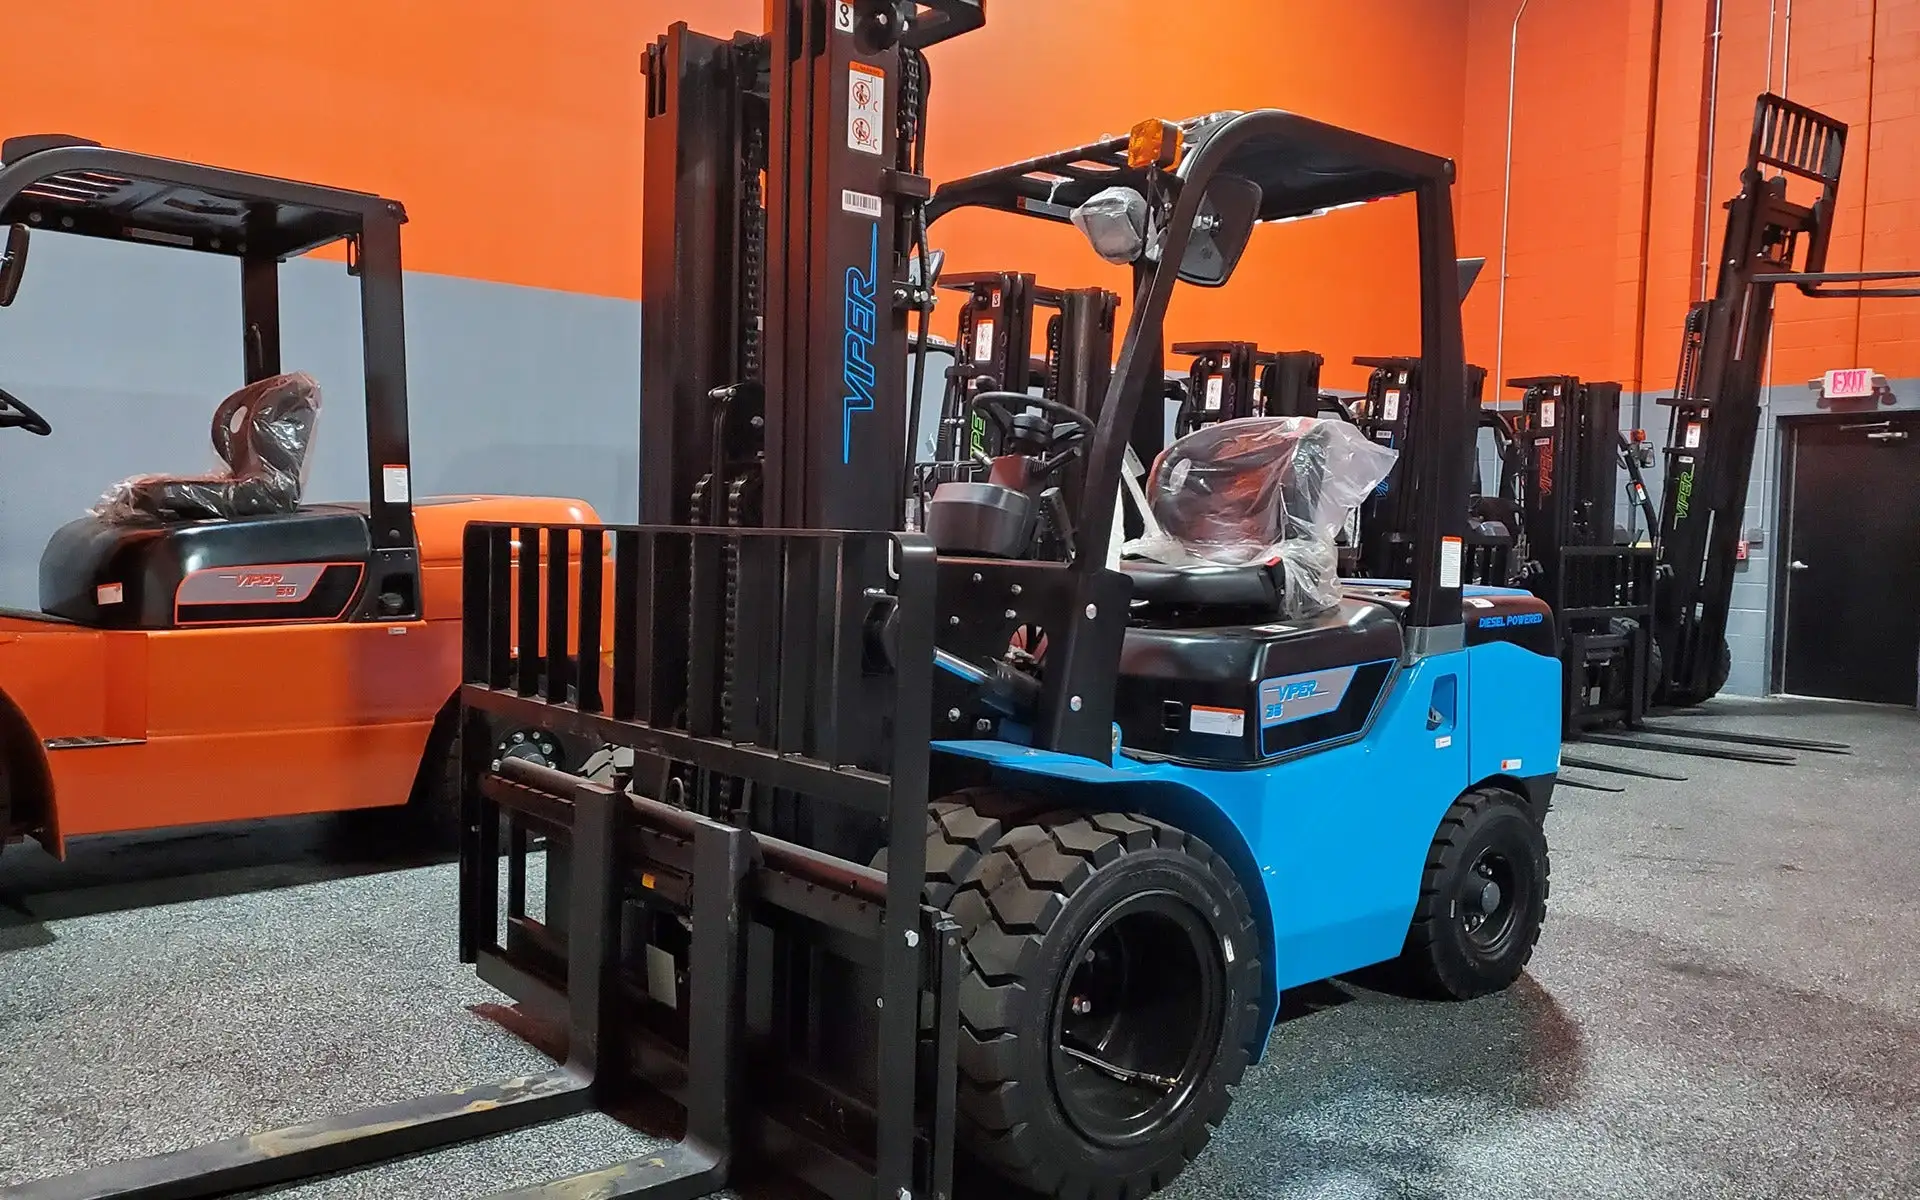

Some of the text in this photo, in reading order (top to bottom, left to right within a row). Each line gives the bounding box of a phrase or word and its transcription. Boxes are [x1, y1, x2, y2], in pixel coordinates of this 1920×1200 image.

[843, 223, 877, 464] VIPER
[1832, 371, 1867, 394] EXIT
[1673, 464, 1695, 530] VIPER
[219, 574, 297, 587] VIPER
[1479, 613, 1543, 628] DIESEL POWERED
[1264, 680, 1329, 702] VIPER
